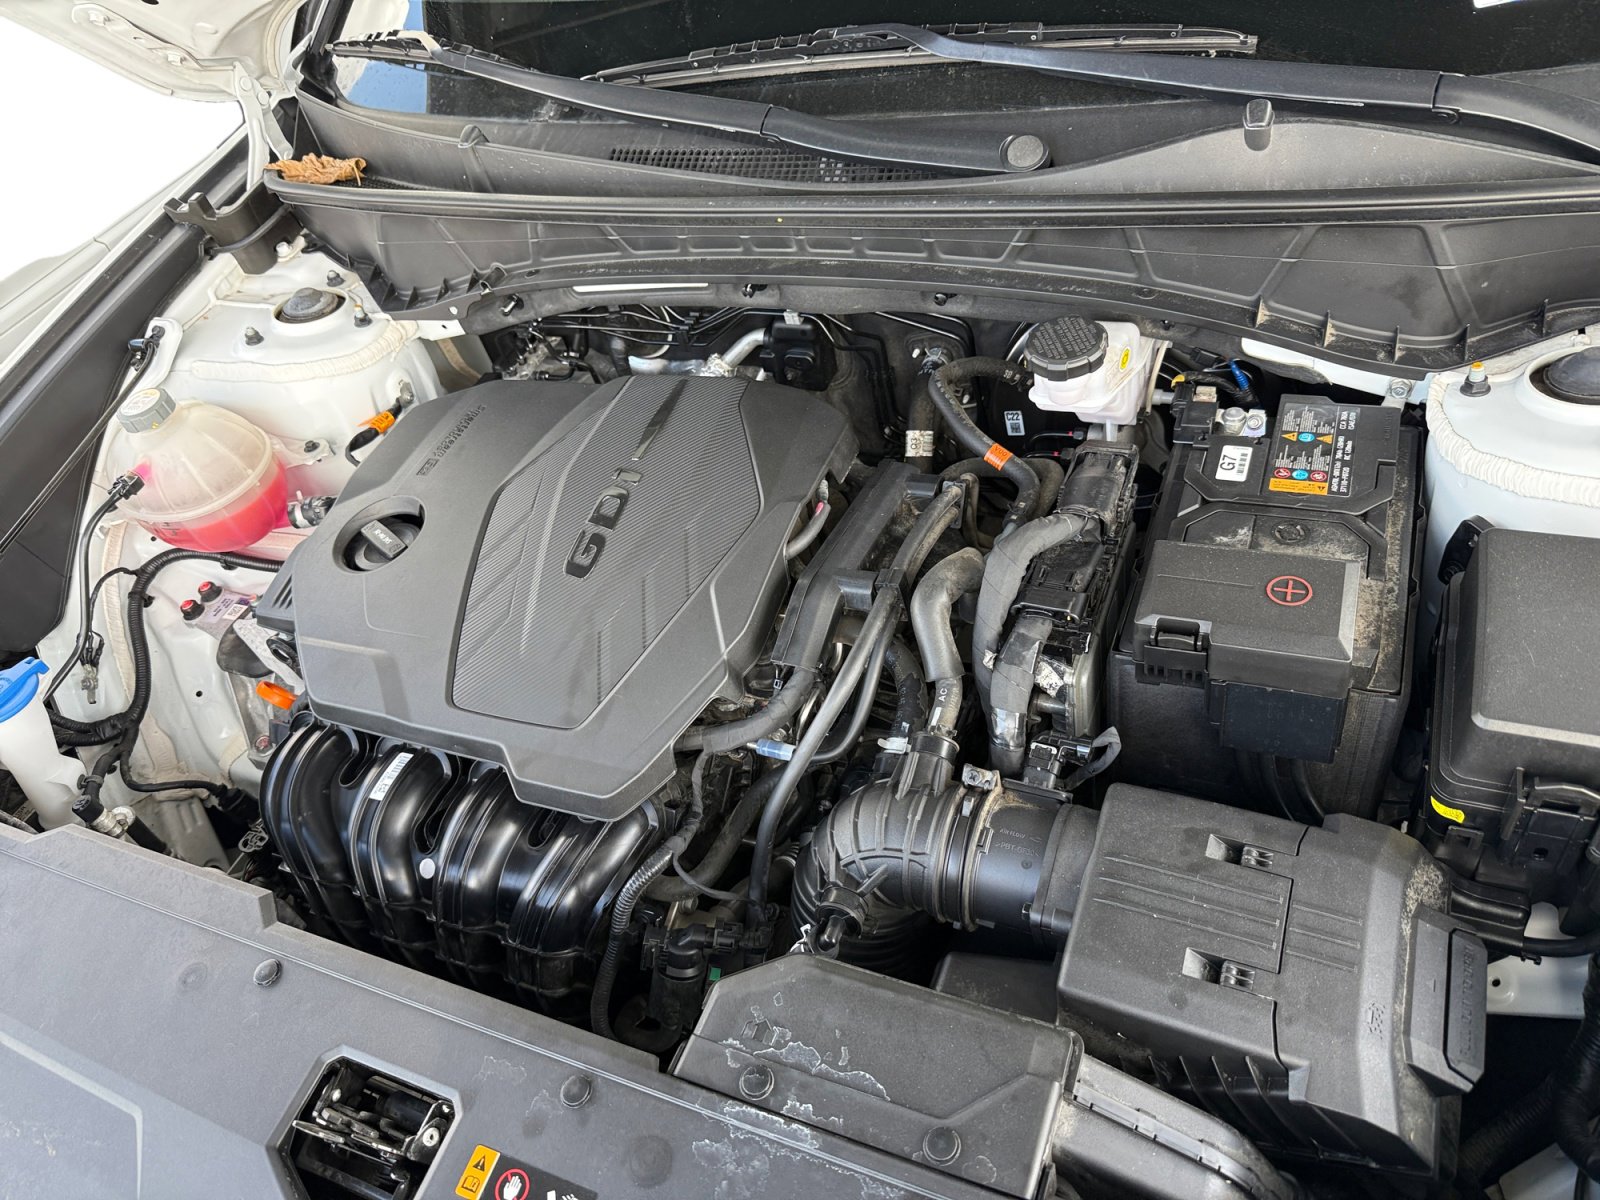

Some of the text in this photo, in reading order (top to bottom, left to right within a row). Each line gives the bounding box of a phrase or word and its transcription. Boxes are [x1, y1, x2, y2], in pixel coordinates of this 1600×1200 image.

[1005, 412, 1020, 421] C22
[437, 404, 486, 457] Smartstream
[1339, 420, 1347, 430] CCA
[1219, 454, 1237, 471] G7
[938, 688, 948, 702] AC
